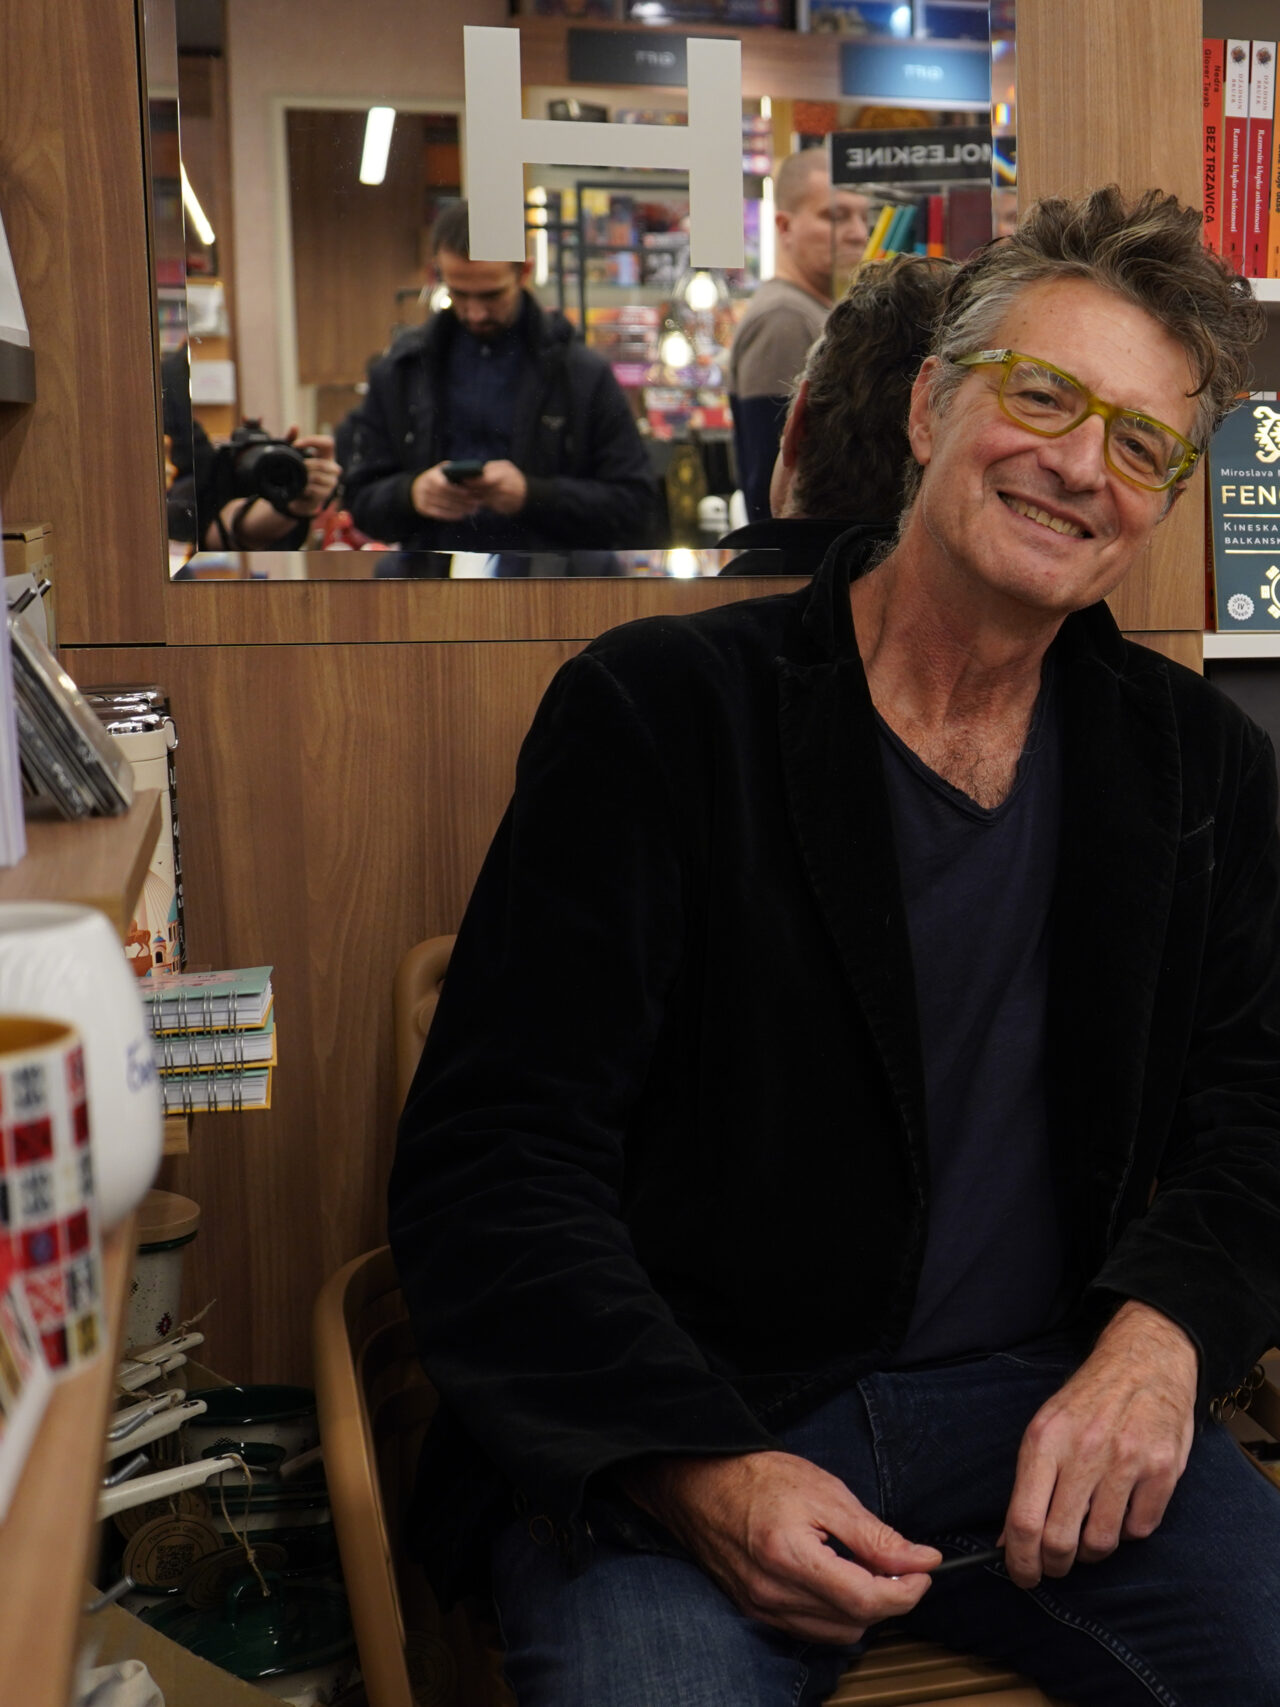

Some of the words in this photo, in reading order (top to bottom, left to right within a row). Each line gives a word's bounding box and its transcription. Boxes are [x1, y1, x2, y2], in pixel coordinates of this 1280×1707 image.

[1205, 126, 1216, 154] BEZ
[1204, 157, 1216, 224] TRZAVICA
[1221, 469, 1273, 477] Miroslava
[1224, 522, 1278, 532] KINESKA
